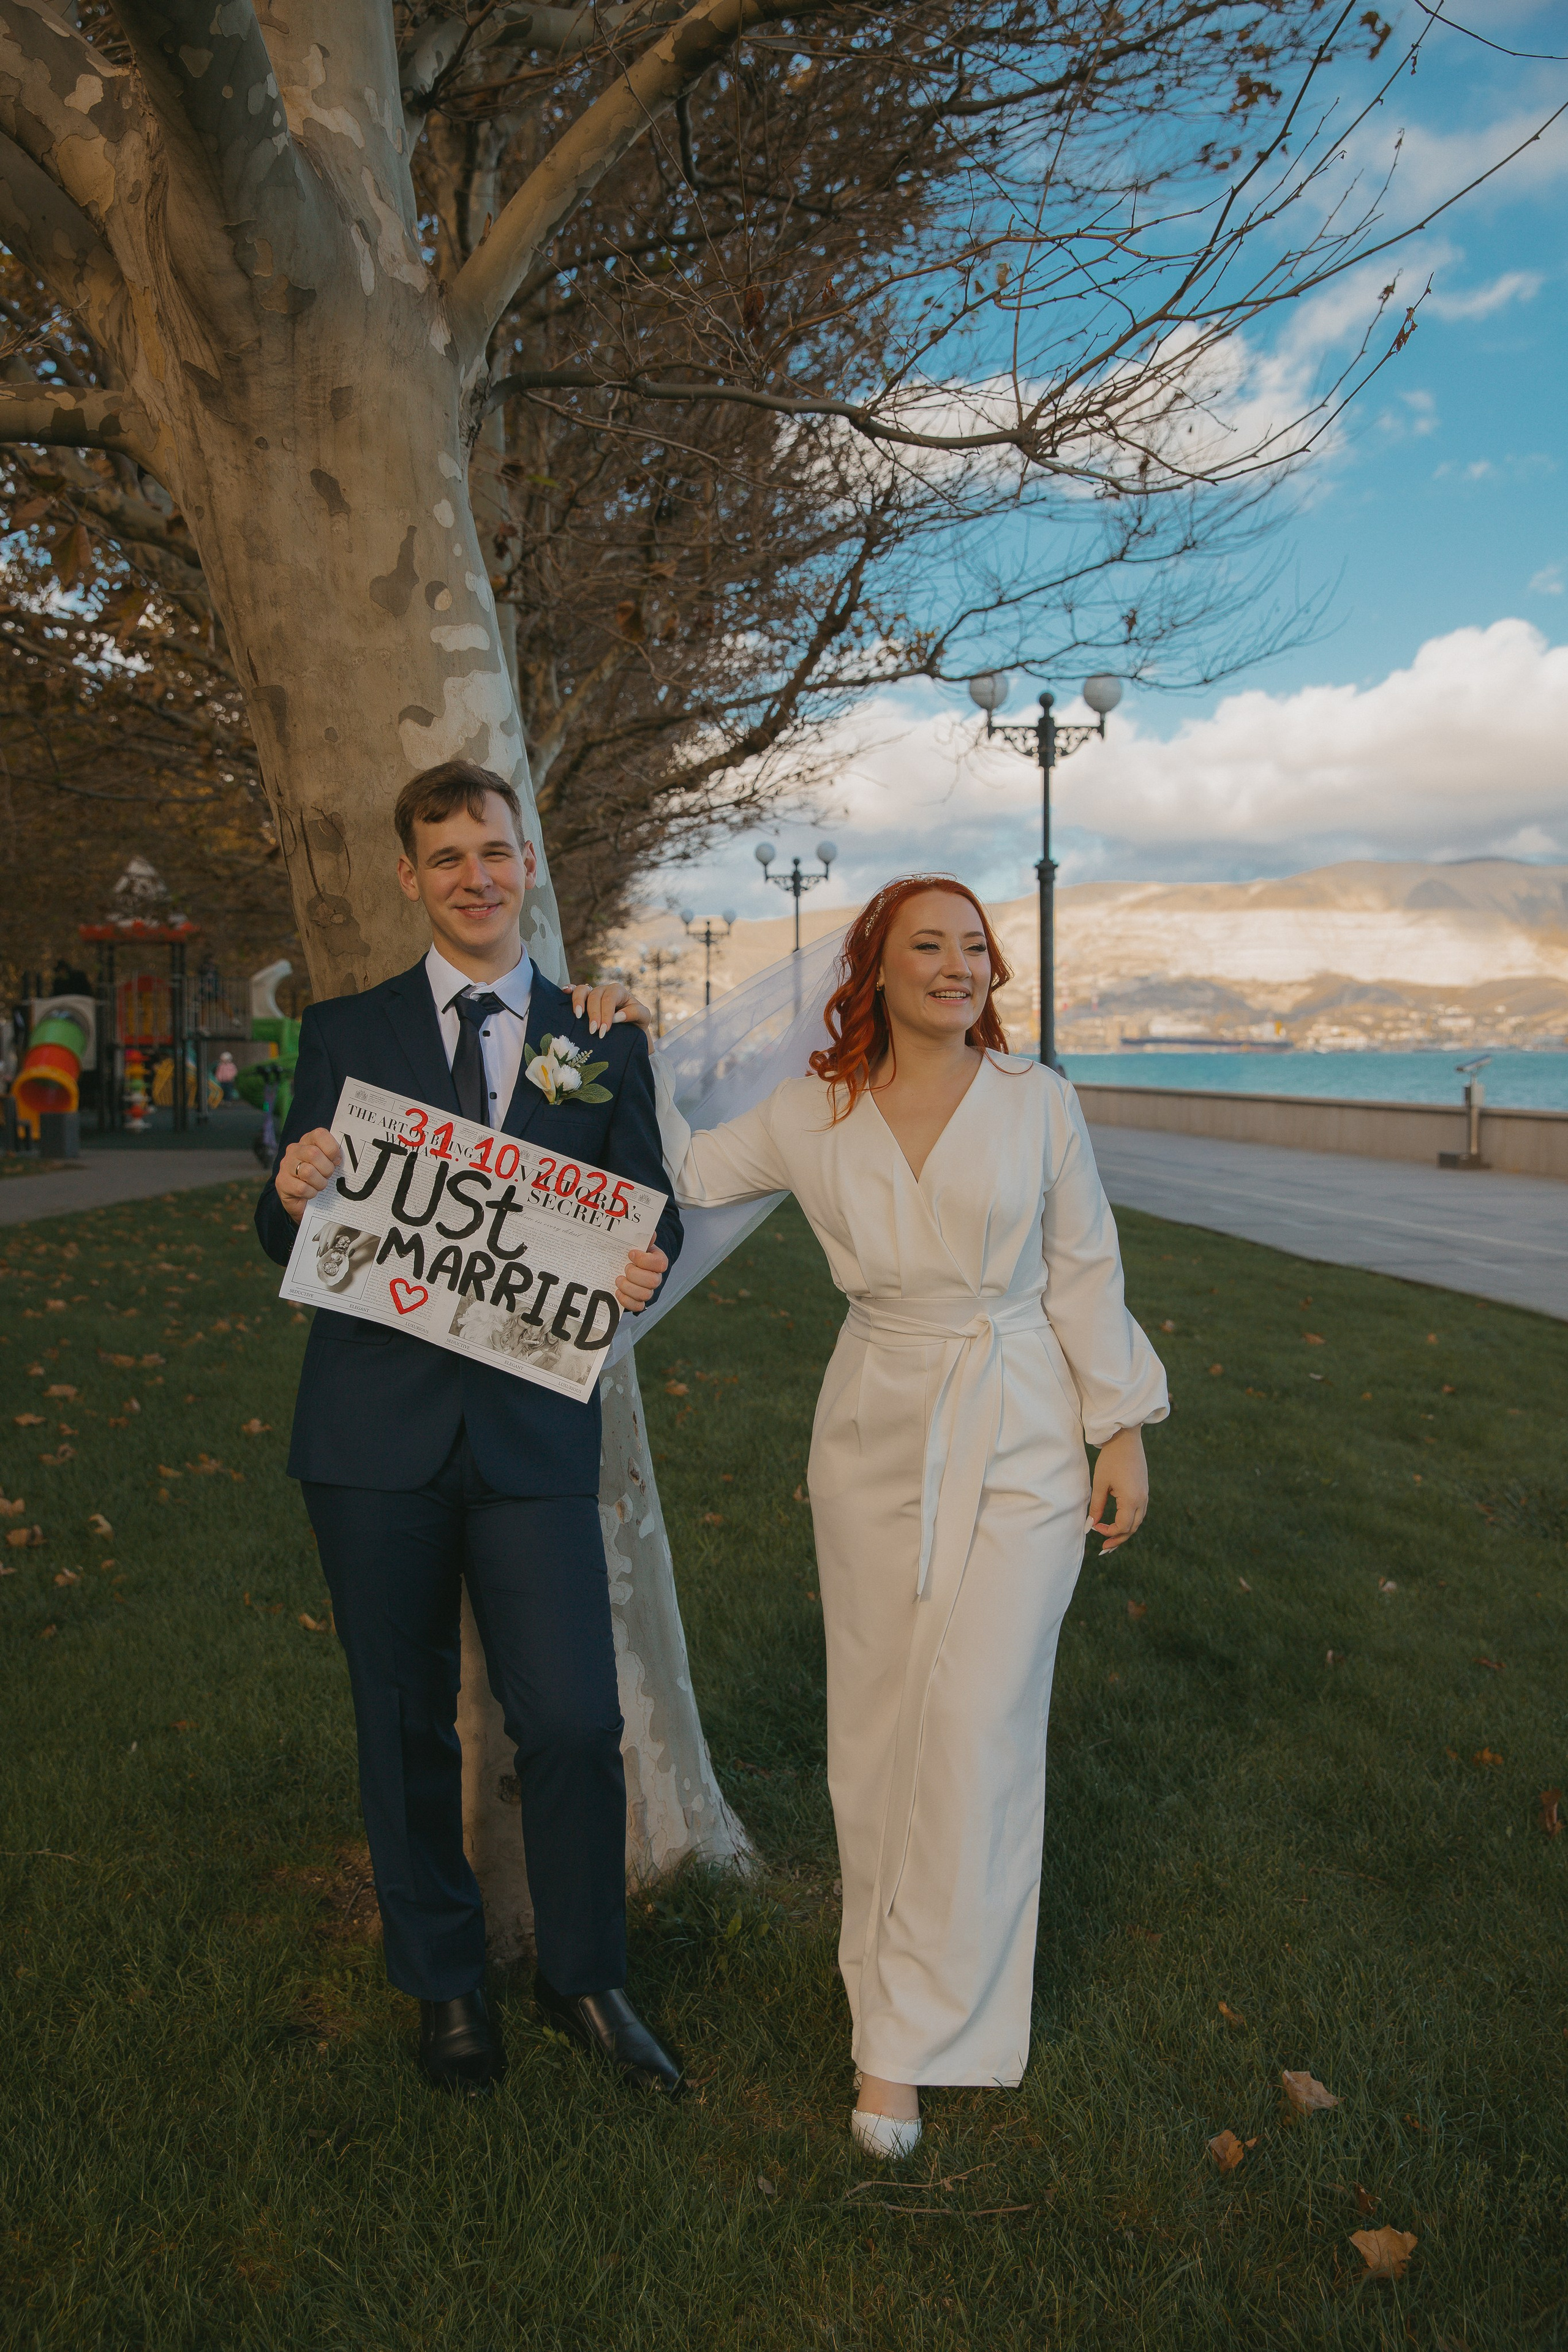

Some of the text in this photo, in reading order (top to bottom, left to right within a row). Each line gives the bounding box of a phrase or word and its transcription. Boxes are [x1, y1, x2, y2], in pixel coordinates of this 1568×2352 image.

[348, 1103, 377, 1123] THE
[377, 1116, 408, 1134] ART
[527, 1189, 620, 1233] SECRET
[562, 1227, 584, 1238] detail
[289, 1288, 429, 1334] SEDUCTIVE ELEGANT LUXURIOUS
[376, 1227, 620, 1350] MARRIED
[446, 1338, 582, 1394] SEDUCTIVE ELEGANT LUXURIOUS
